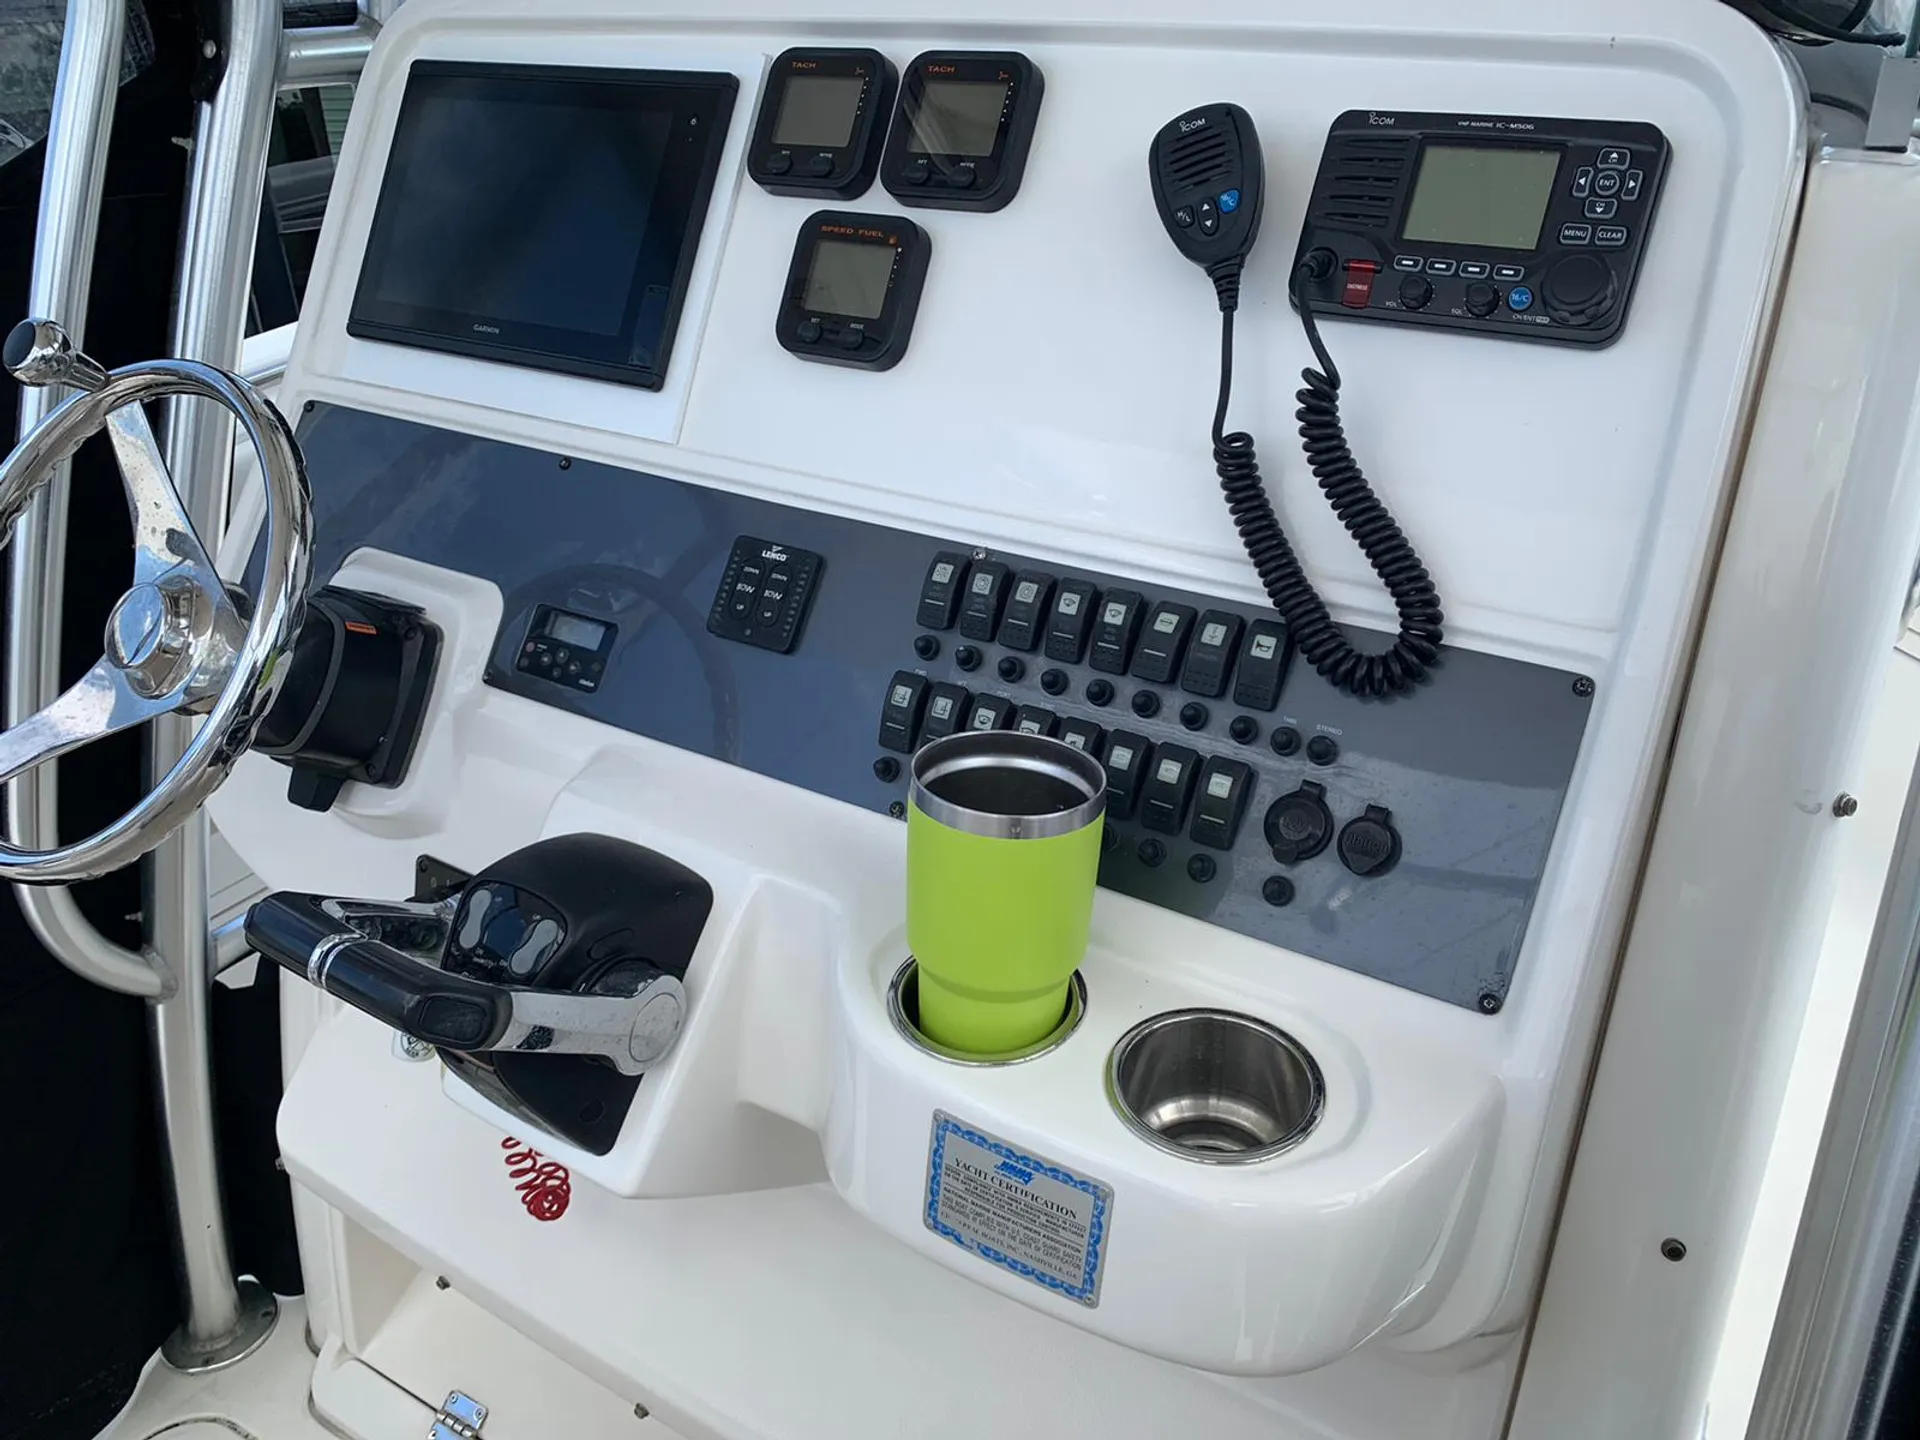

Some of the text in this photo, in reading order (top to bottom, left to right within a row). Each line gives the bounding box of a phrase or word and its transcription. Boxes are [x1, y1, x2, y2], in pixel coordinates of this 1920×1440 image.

[791, 61, 816, 69] TACH
[1495, 122, 1535, 130] IC-M506
[1599, 179, 1615, 187] ENT
[819, 225, 885, 239] SPEED FUEL
[1563, 229, 1587, 238] MENU
[1598, 231, 1622, 239] CLEAR
[762, 550, 787, 562] LENCO
[764, 590, 783, 600] BOW
[1316, 724, 1343, 736] STEREO
[954, 1157, 988, 1181] YACHT
[990, 1173, 1078, 1221] CERTIFICATION
[942, 1185, 1081, 1255] NATIONAL MARINE MANUFACTURERS ASSOCIATION
[954, 1199, 968, 1211] BOAT
[995, 1219, 1009, 1231] WITH
[1021, 1231, 1040, 1245] COAST
[978, 1218, 996, 1232] EFFECT
[1041, 1247, 1081, 1271] CERTIFICATION
